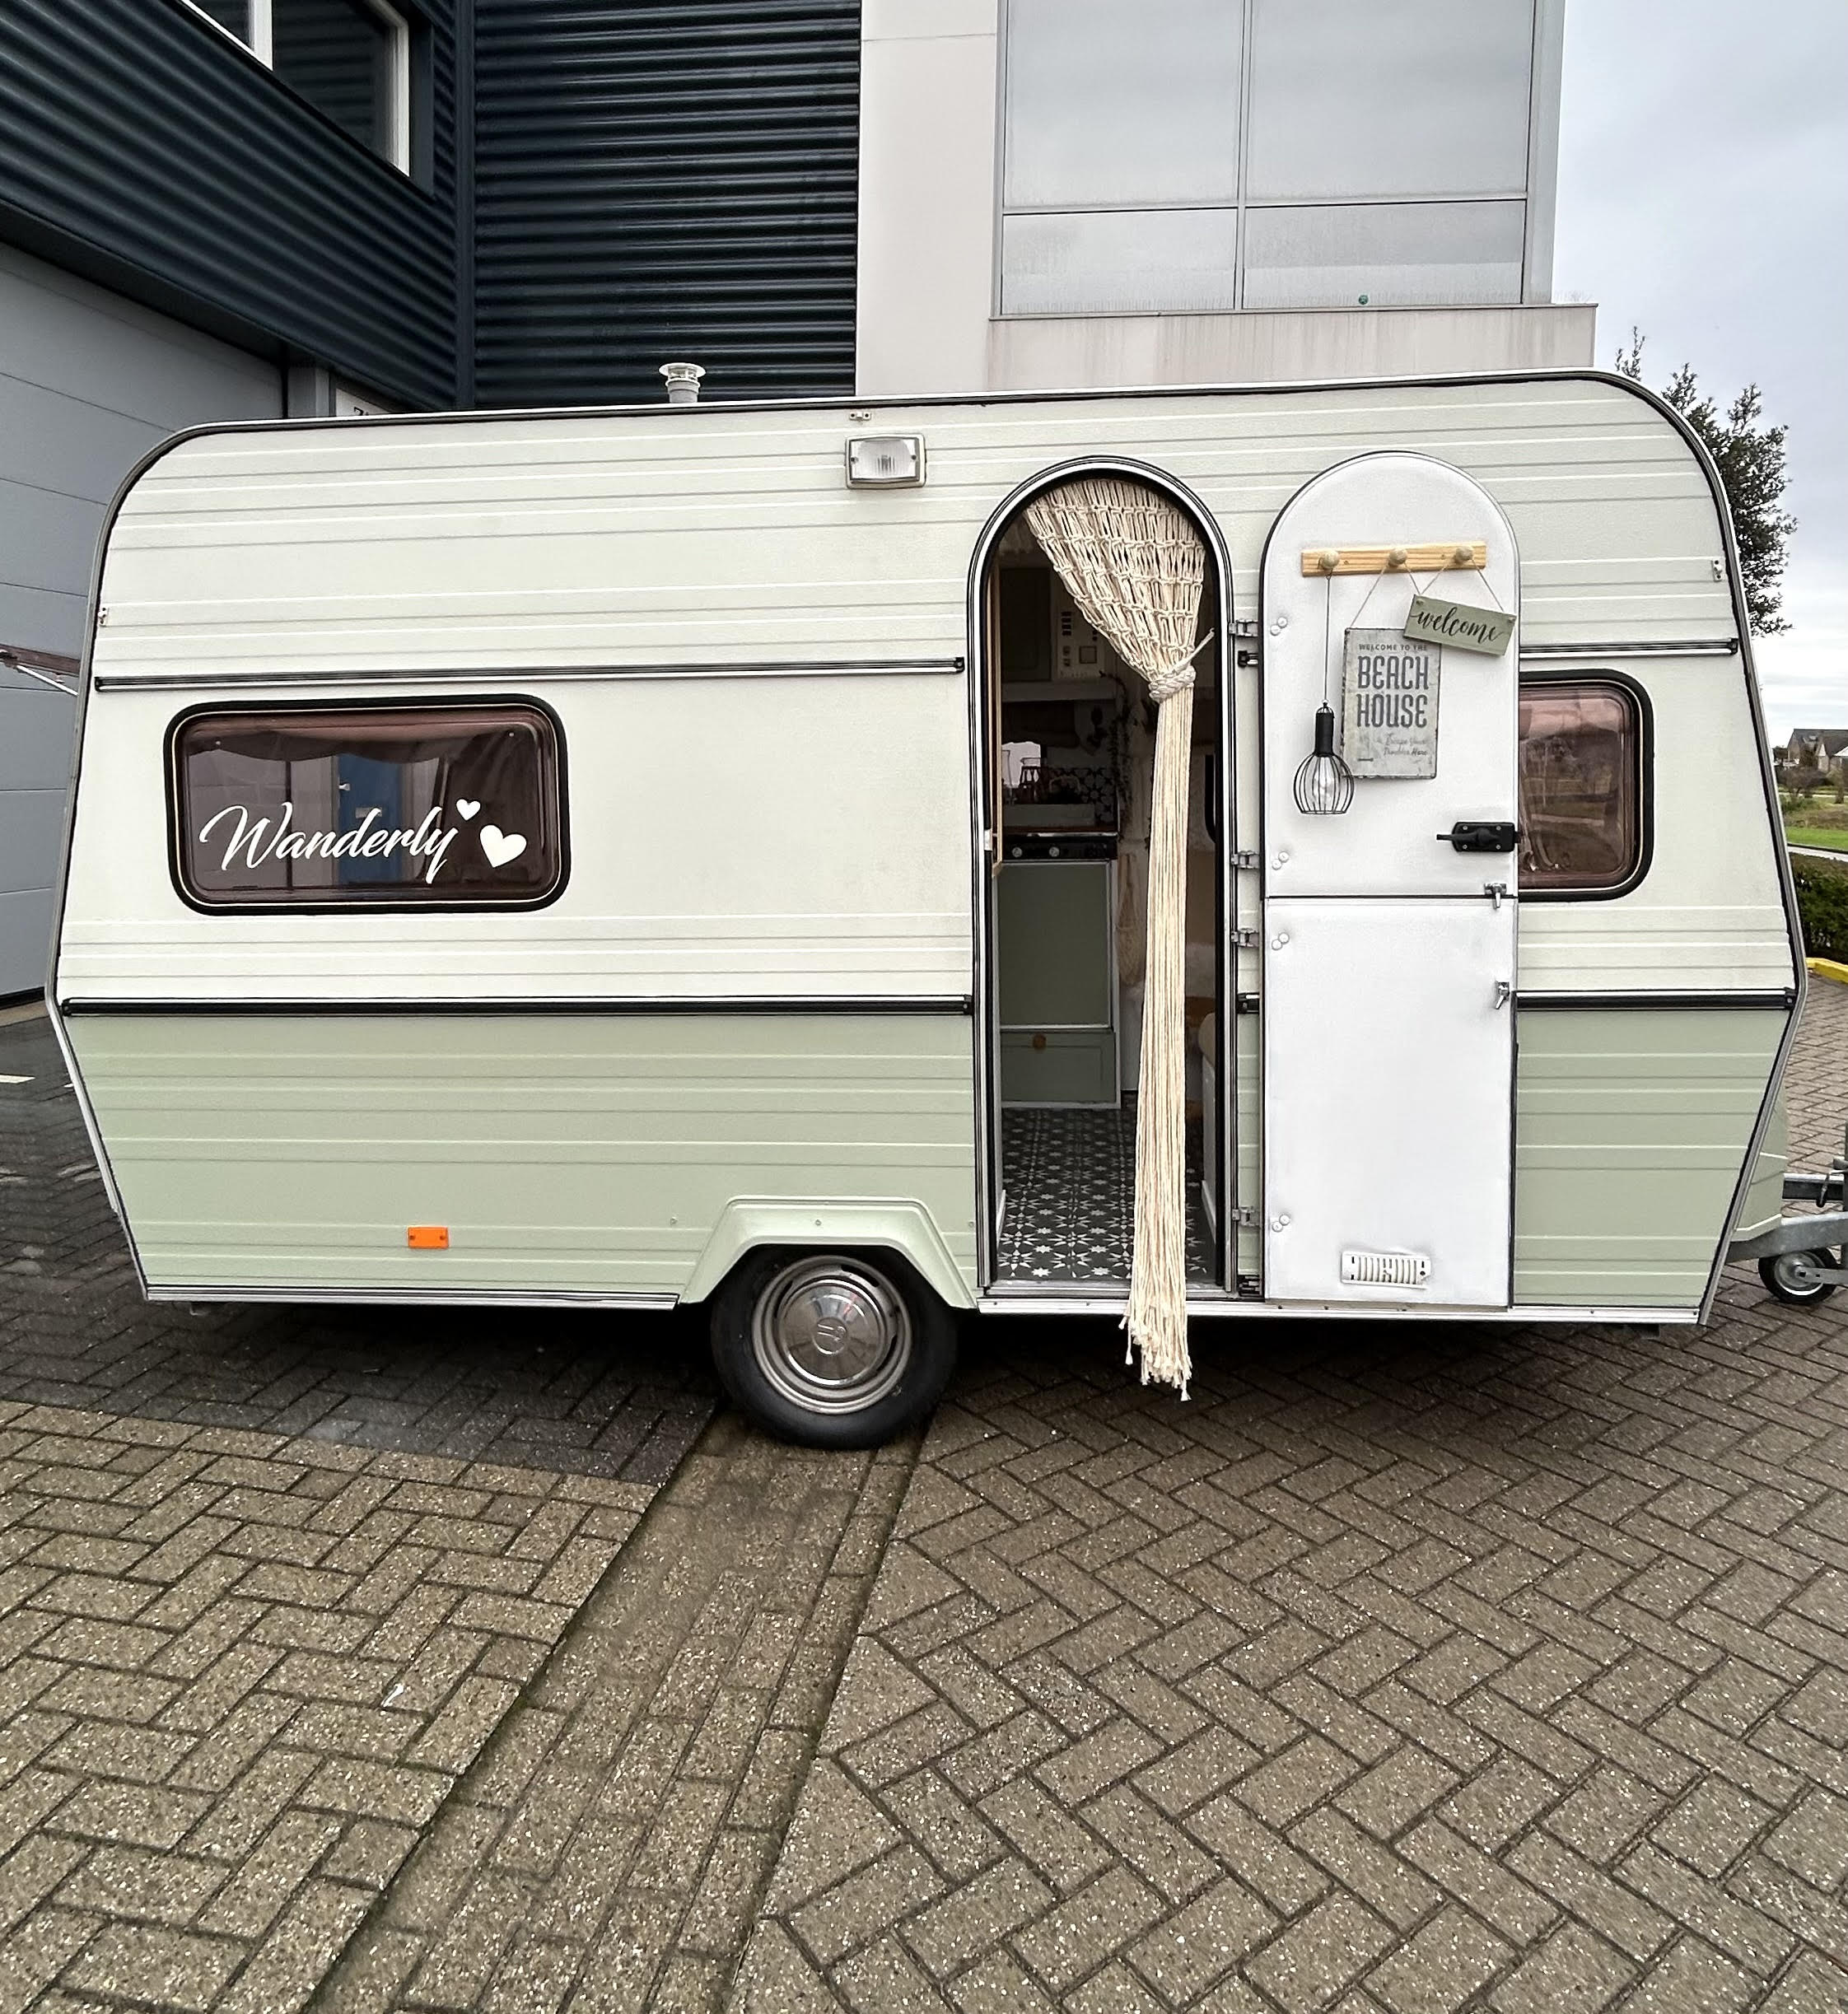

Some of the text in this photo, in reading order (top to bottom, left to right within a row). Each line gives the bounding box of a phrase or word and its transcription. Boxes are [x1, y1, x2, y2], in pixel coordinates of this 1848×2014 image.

[1410, 607, 1505, 644] welcome
[1358, 655, 1429, 689] BEACH
[1356, 694, 1428, 728] HOUSE
[198, 801, 459, 884] Wanderly
